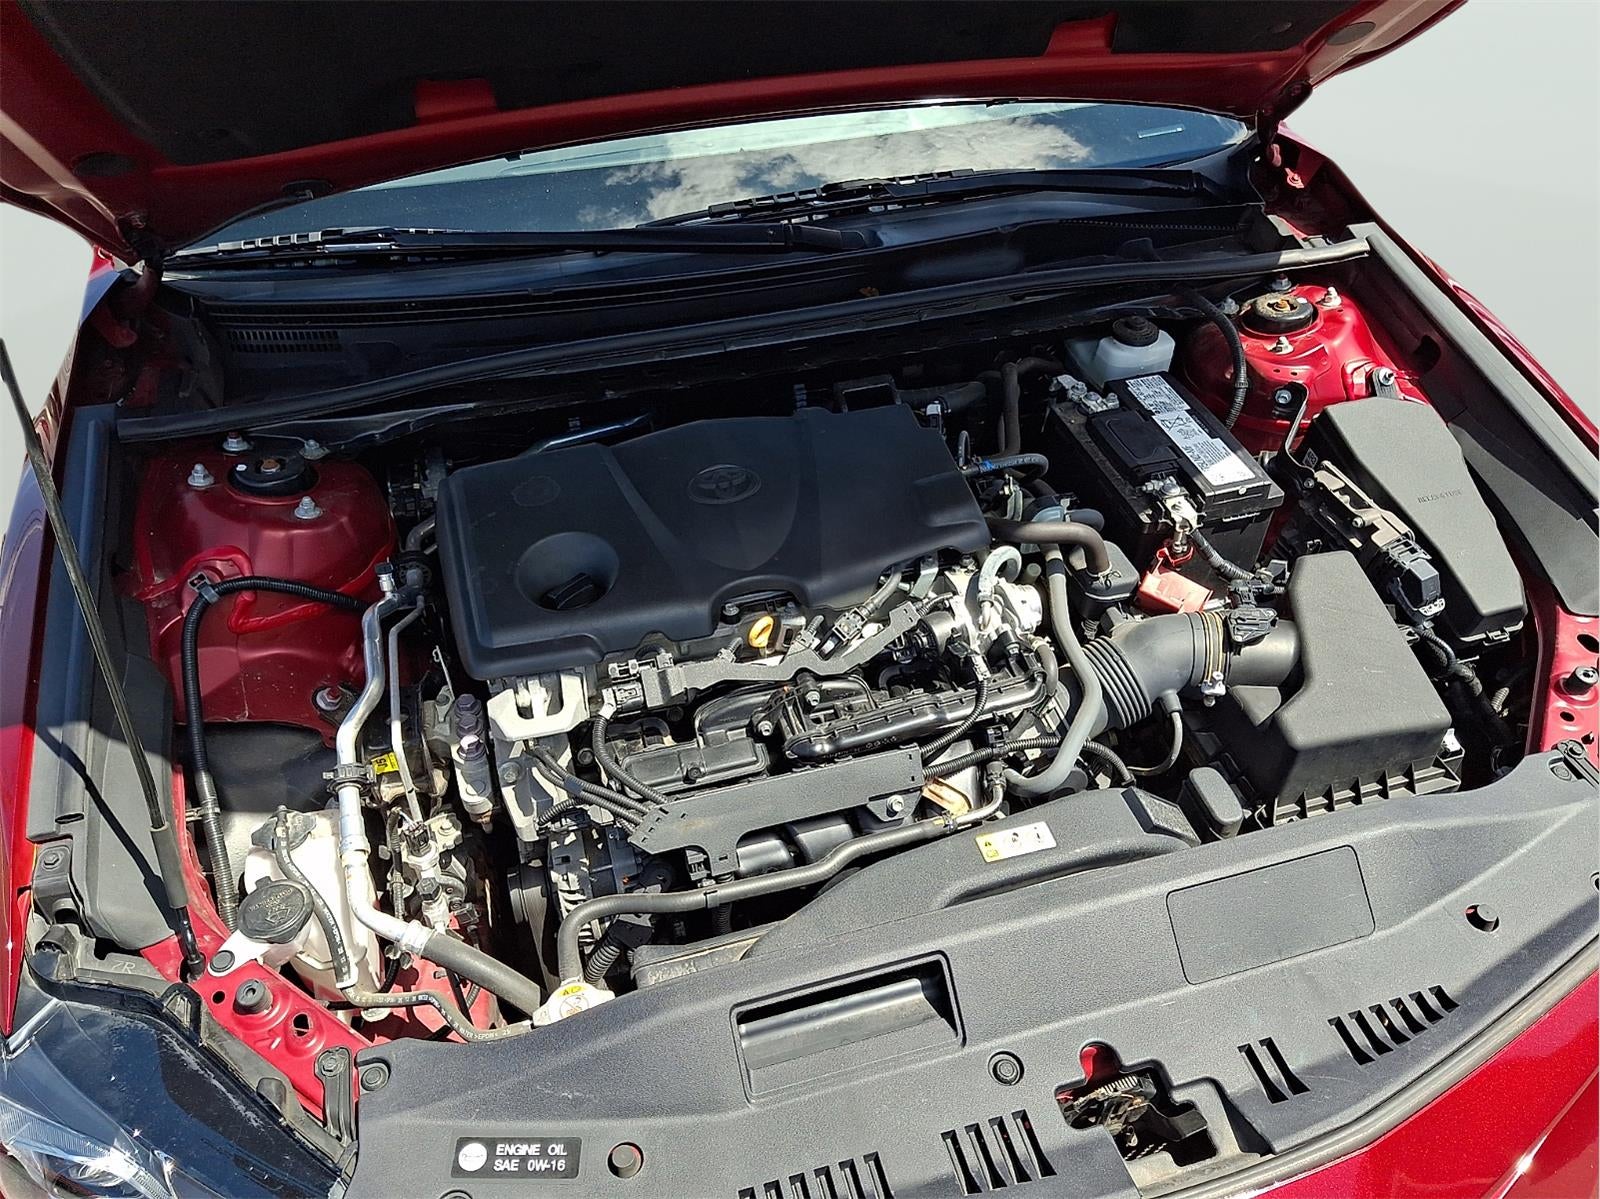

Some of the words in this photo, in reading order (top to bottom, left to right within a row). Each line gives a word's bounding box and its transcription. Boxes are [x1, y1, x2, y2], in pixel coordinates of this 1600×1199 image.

[495, 1143, 541, 1156] ENGINE
[547, 1143, 568, 1156] OIL
[493, 1159, 519, 1172] SAE
[527, 1159, 566, 1172] 0W-16
